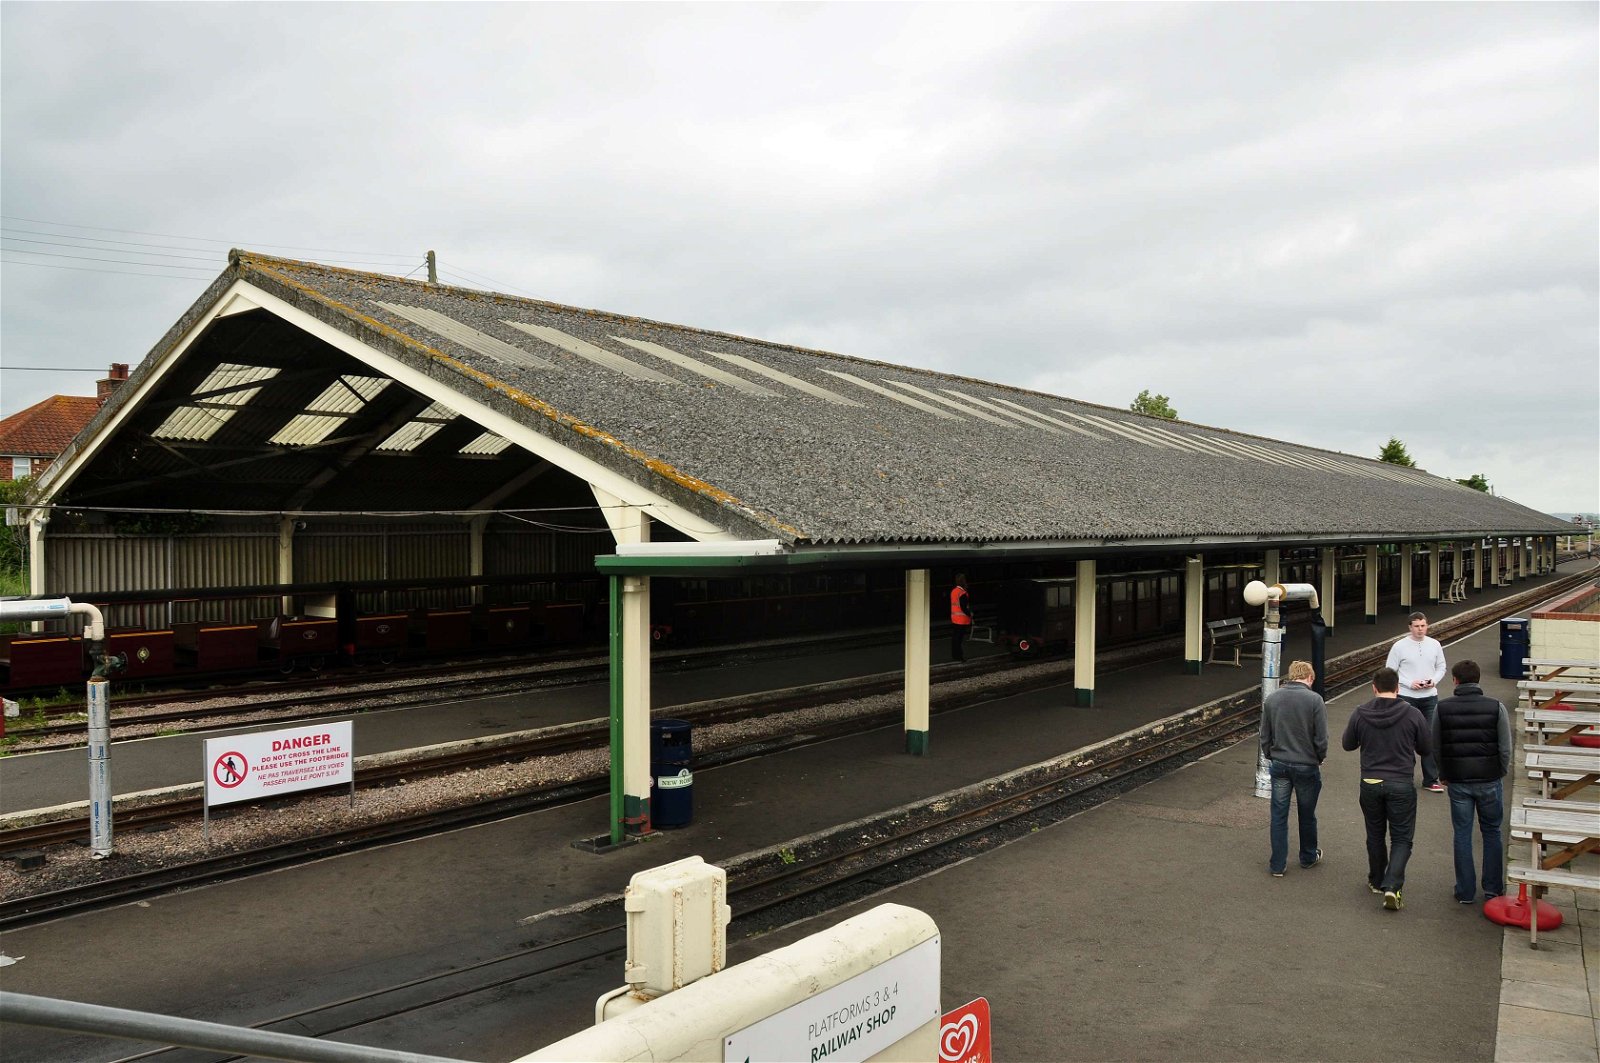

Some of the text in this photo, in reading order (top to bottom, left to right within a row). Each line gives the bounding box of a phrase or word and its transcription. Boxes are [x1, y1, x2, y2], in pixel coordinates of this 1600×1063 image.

[272, 734, 331, 752] DANGER
[252, 763, 278, 772] PLEASE
[309, 752, 349, 763] FOOTBRIDGE
[289, 751, 310, 759] CROSS
[263, 778, 287, 787] PASSER
[309, 771, 325, 780] PONT
[268, 771, 279, 779] PAS
[281, 766, 315, 777] TRAVERSEZ
[328, 761, 345, 769] VOIES
[808, 981, 898, 1040] PLATFORMS 3 & 4
[811, 1005, 896, 1063] RAILWAY SHOP
